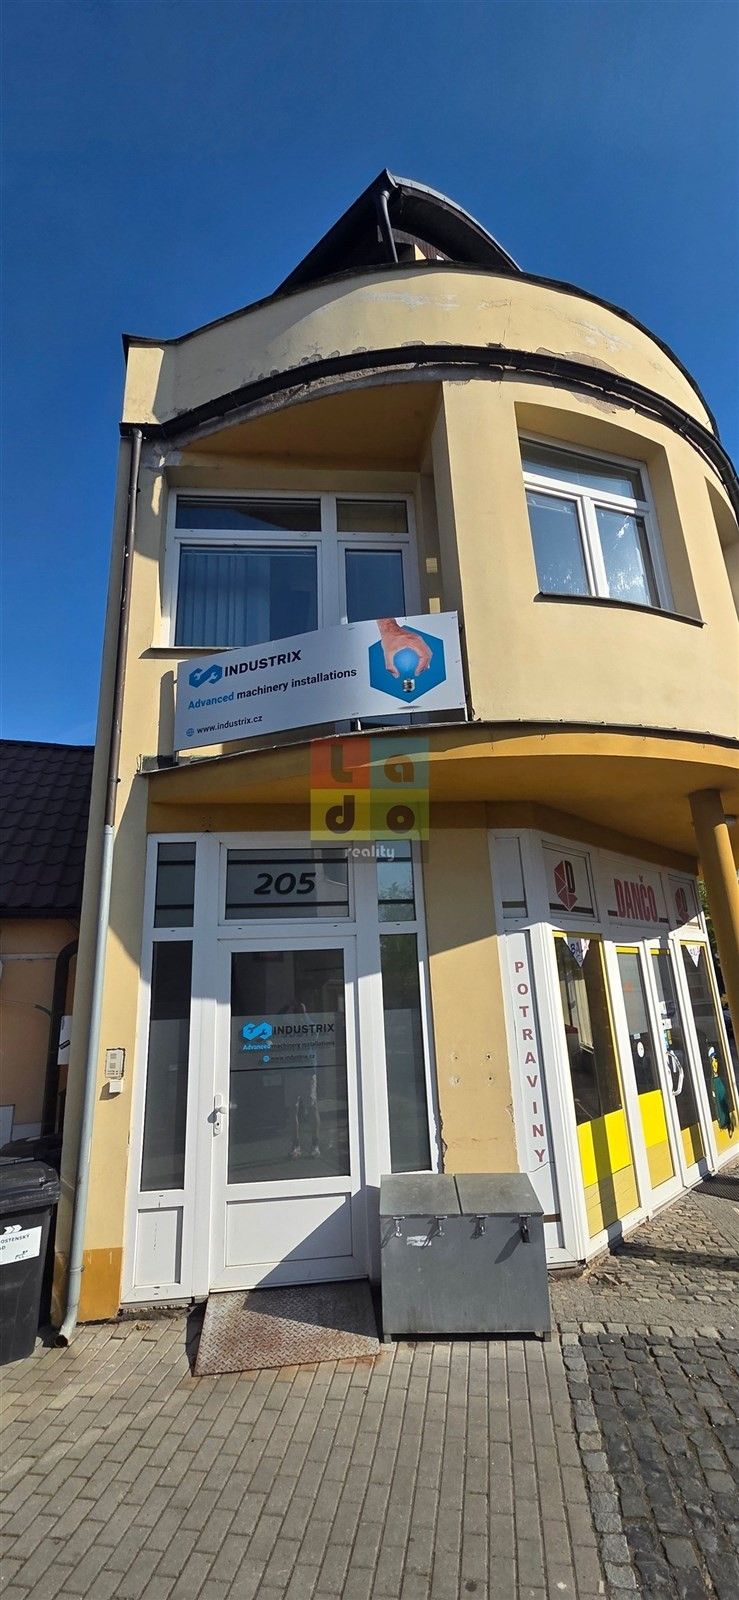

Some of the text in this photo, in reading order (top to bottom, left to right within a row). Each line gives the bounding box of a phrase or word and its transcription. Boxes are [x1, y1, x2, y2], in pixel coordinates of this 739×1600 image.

[225, 650, 302, 677] INDUSTRIX
[188, 668, 357, 710] Advanced machinery installations
[196, 714, 263, 735] www.industrix.cz
[254, 872, 317, 895] 205
[613, 874, 658, 922] DANČO
[273, 1023, 335, 1035] INDUSTRIX
[514, 960, 546, 1163] POTRAVINY
